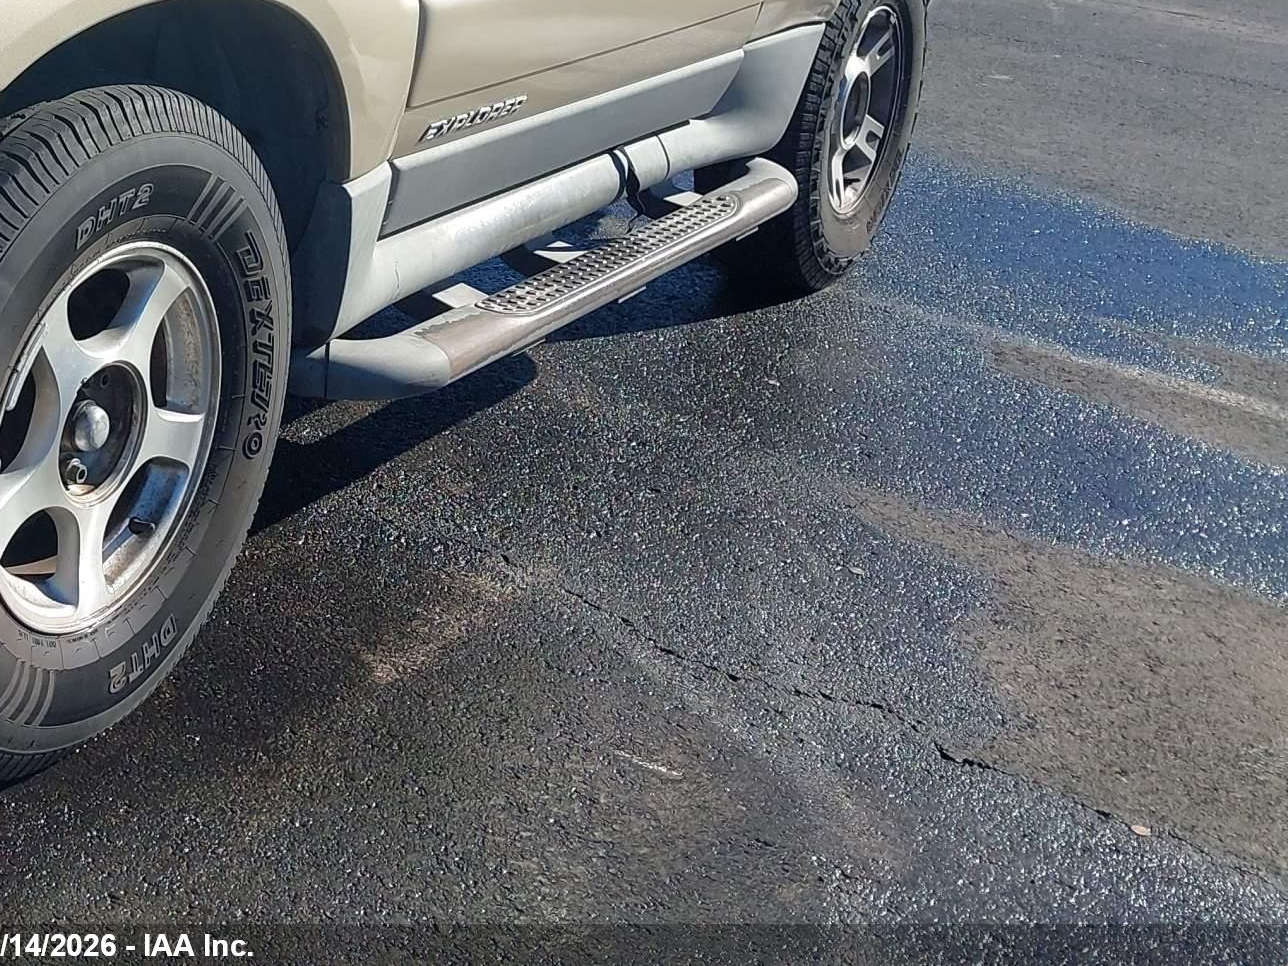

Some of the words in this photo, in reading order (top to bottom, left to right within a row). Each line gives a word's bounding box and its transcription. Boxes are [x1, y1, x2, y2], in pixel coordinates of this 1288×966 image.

[417, 95, 528, 142] EXPLORER
[75, 183, 154, 251] DHT2
[236, 229, 275, 460] DEXTERO
[108, 612, 178, 695] DHT2
